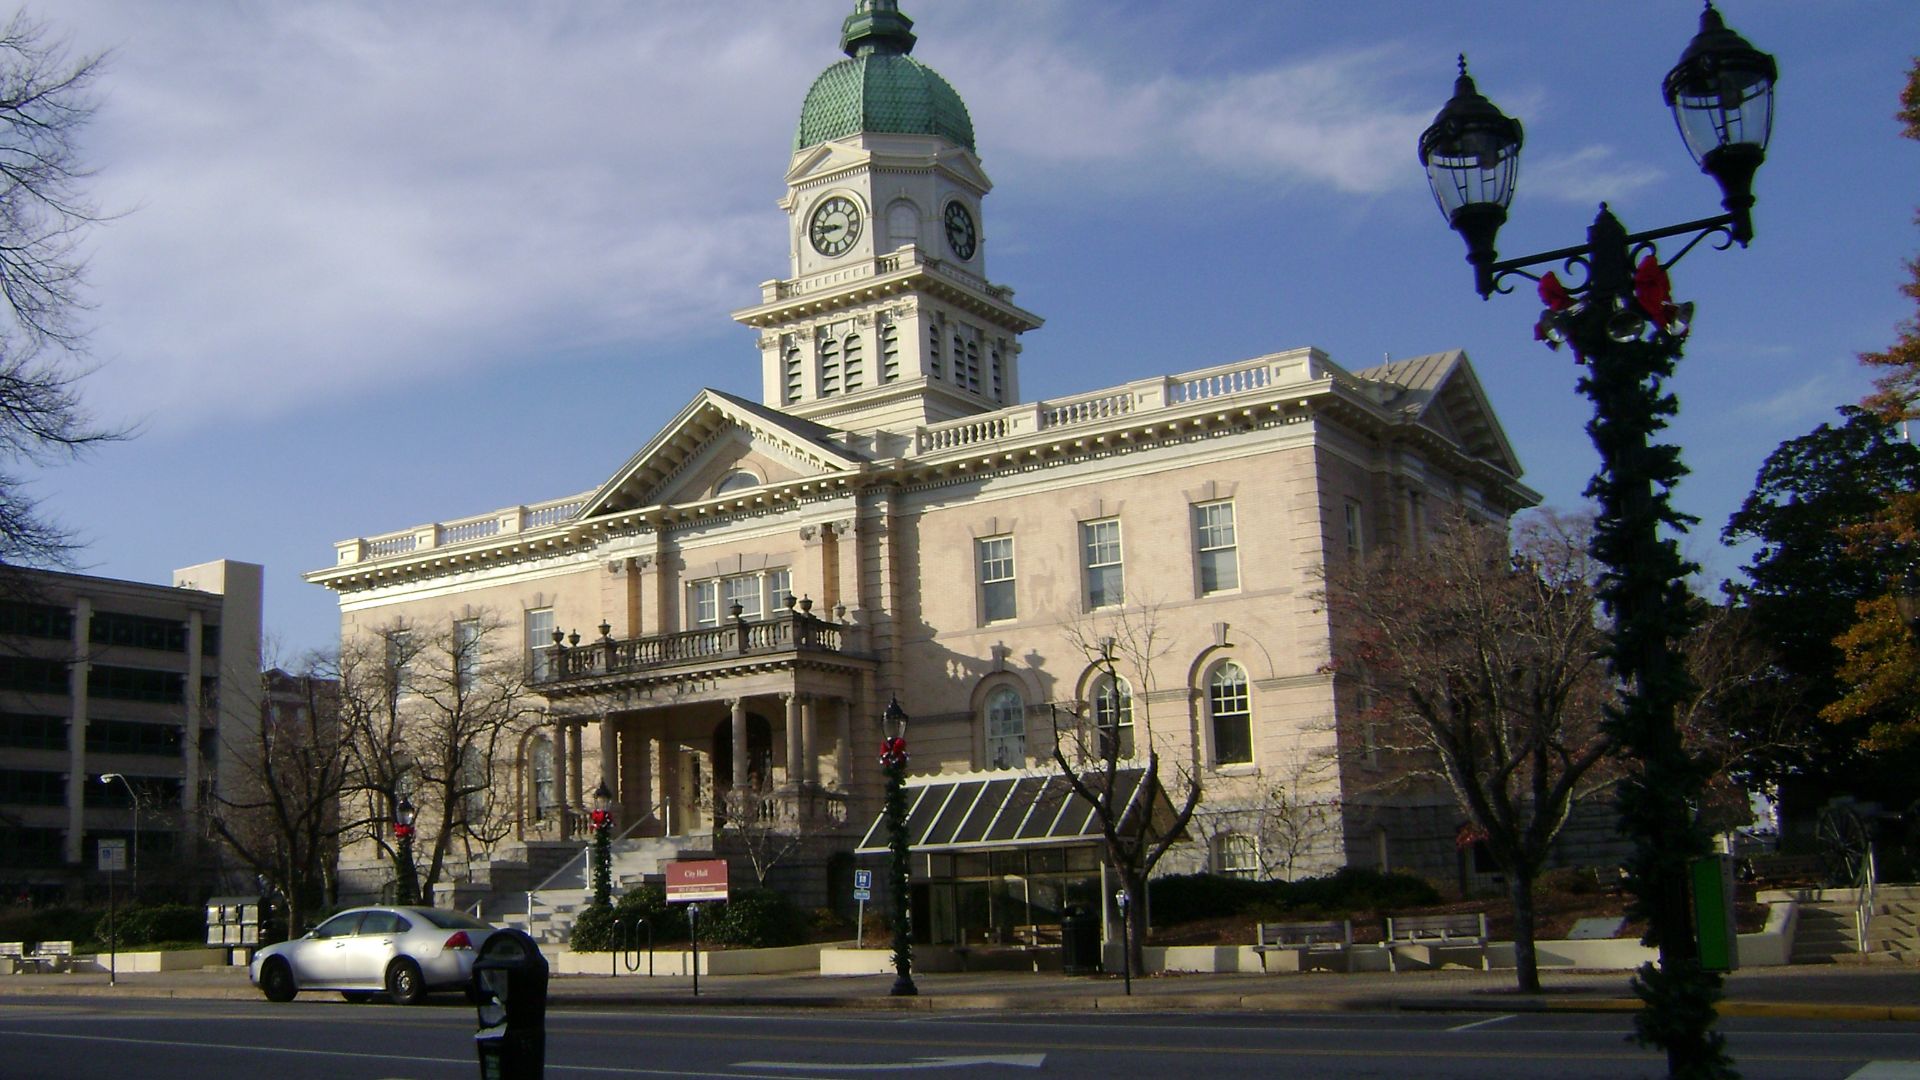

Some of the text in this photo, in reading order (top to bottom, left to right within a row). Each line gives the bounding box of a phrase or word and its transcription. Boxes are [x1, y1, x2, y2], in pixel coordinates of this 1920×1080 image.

[676, 680, 720, 695] HALL
[684, 869, 708, 880] City Hall
